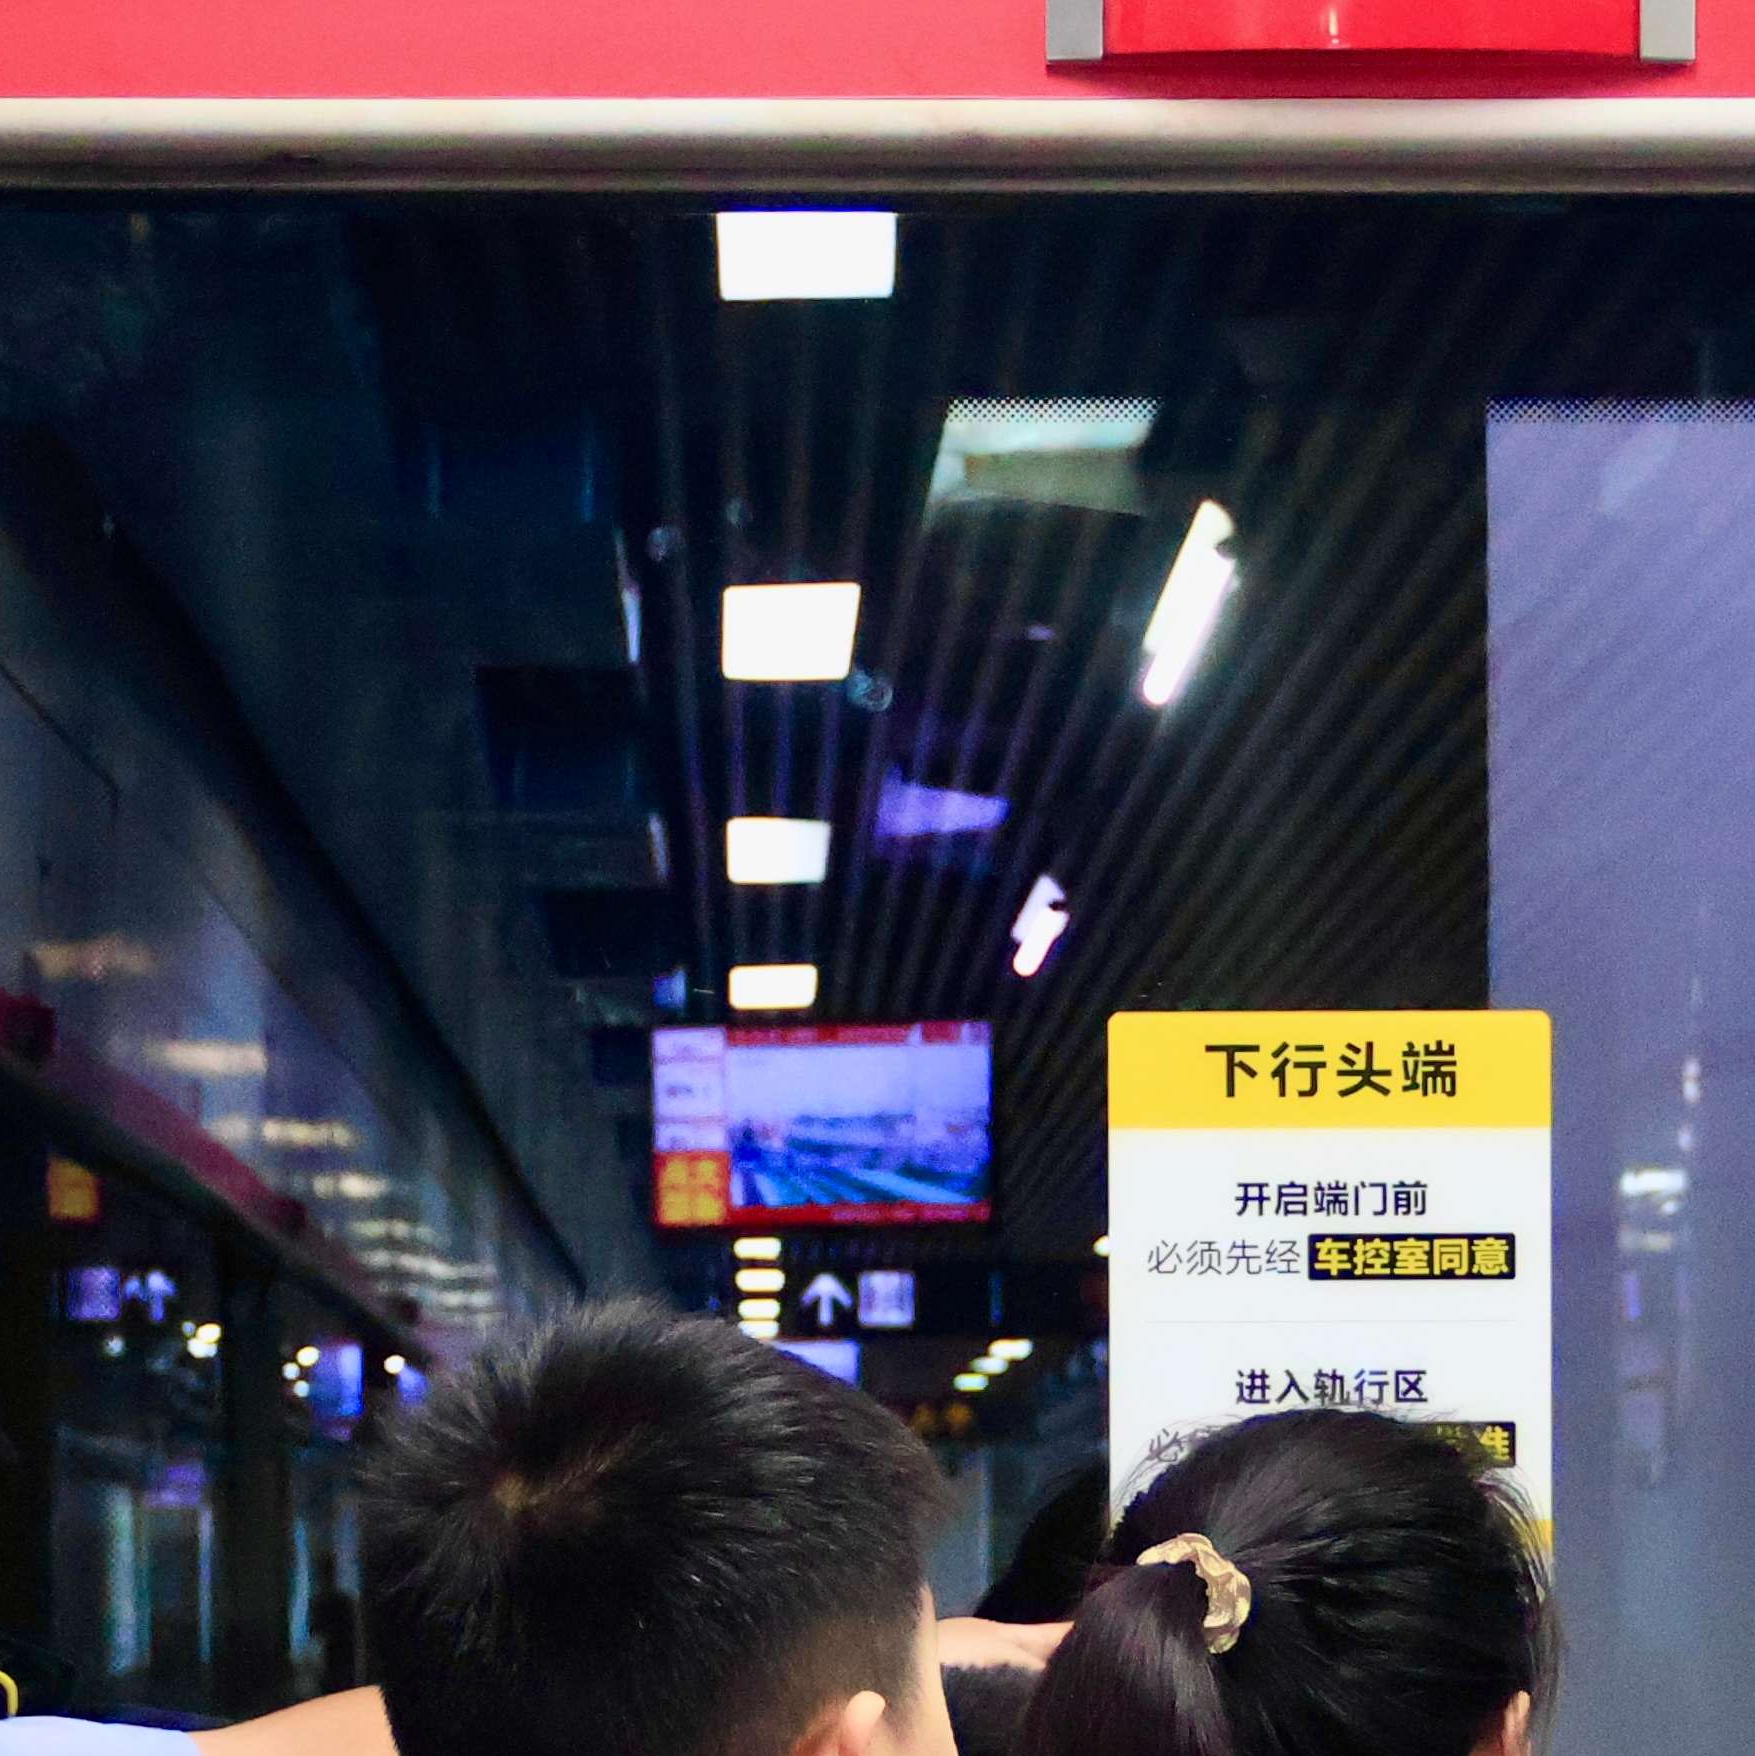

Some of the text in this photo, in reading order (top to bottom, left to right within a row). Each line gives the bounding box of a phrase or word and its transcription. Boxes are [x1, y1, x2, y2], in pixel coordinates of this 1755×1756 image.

[1205, 1041, 1459, 1098] 下行头端
[1235, 1181, 1429, 1217] 开启端门前
[1146, 1236, 1511, 1277] 必须先经 车控室同意
[1235, 1369, 1429, 1405] 进入轨行区
